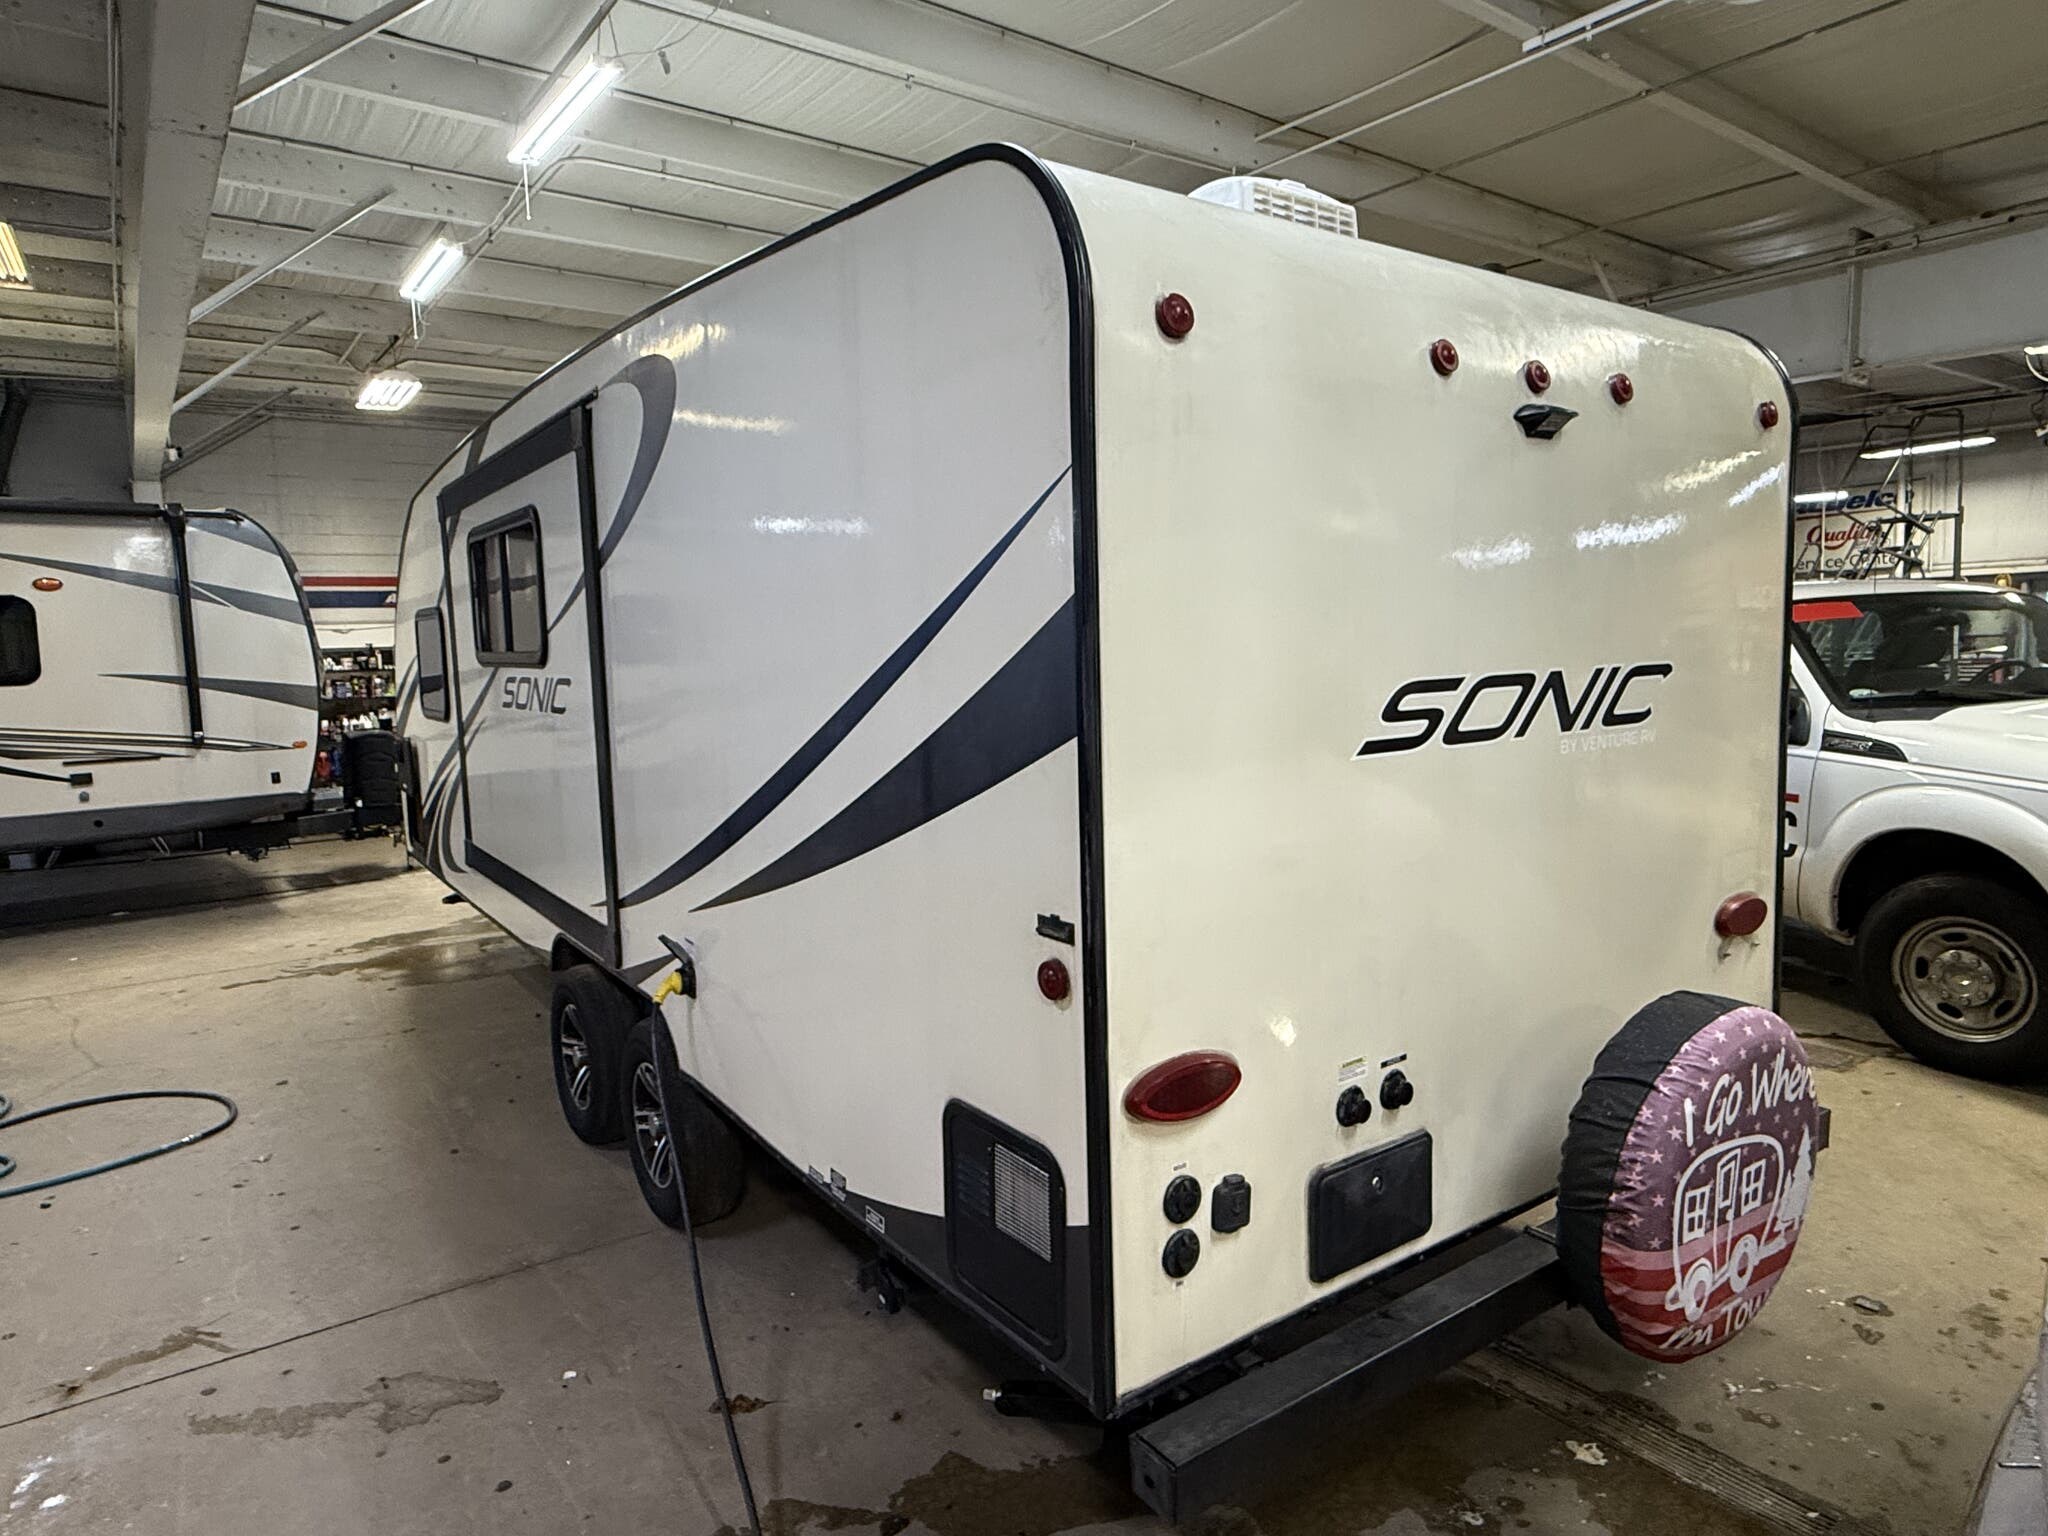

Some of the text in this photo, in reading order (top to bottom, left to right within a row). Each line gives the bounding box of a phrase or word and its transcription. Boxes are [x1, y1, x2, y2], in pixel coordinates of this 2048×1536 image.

[1807, 521, 1884, 550] Qualit
[1850, 552, 1896, 567] Cente
[502, 676, 572, 714] SONIC
[1352, 662, 1673, 759] SONIC
[1560, 728, 1656, 755] BY VENTURE RV
[1683, 1097, 1695, 1147] I
[1704, 1073, 1743, 1137] Go
